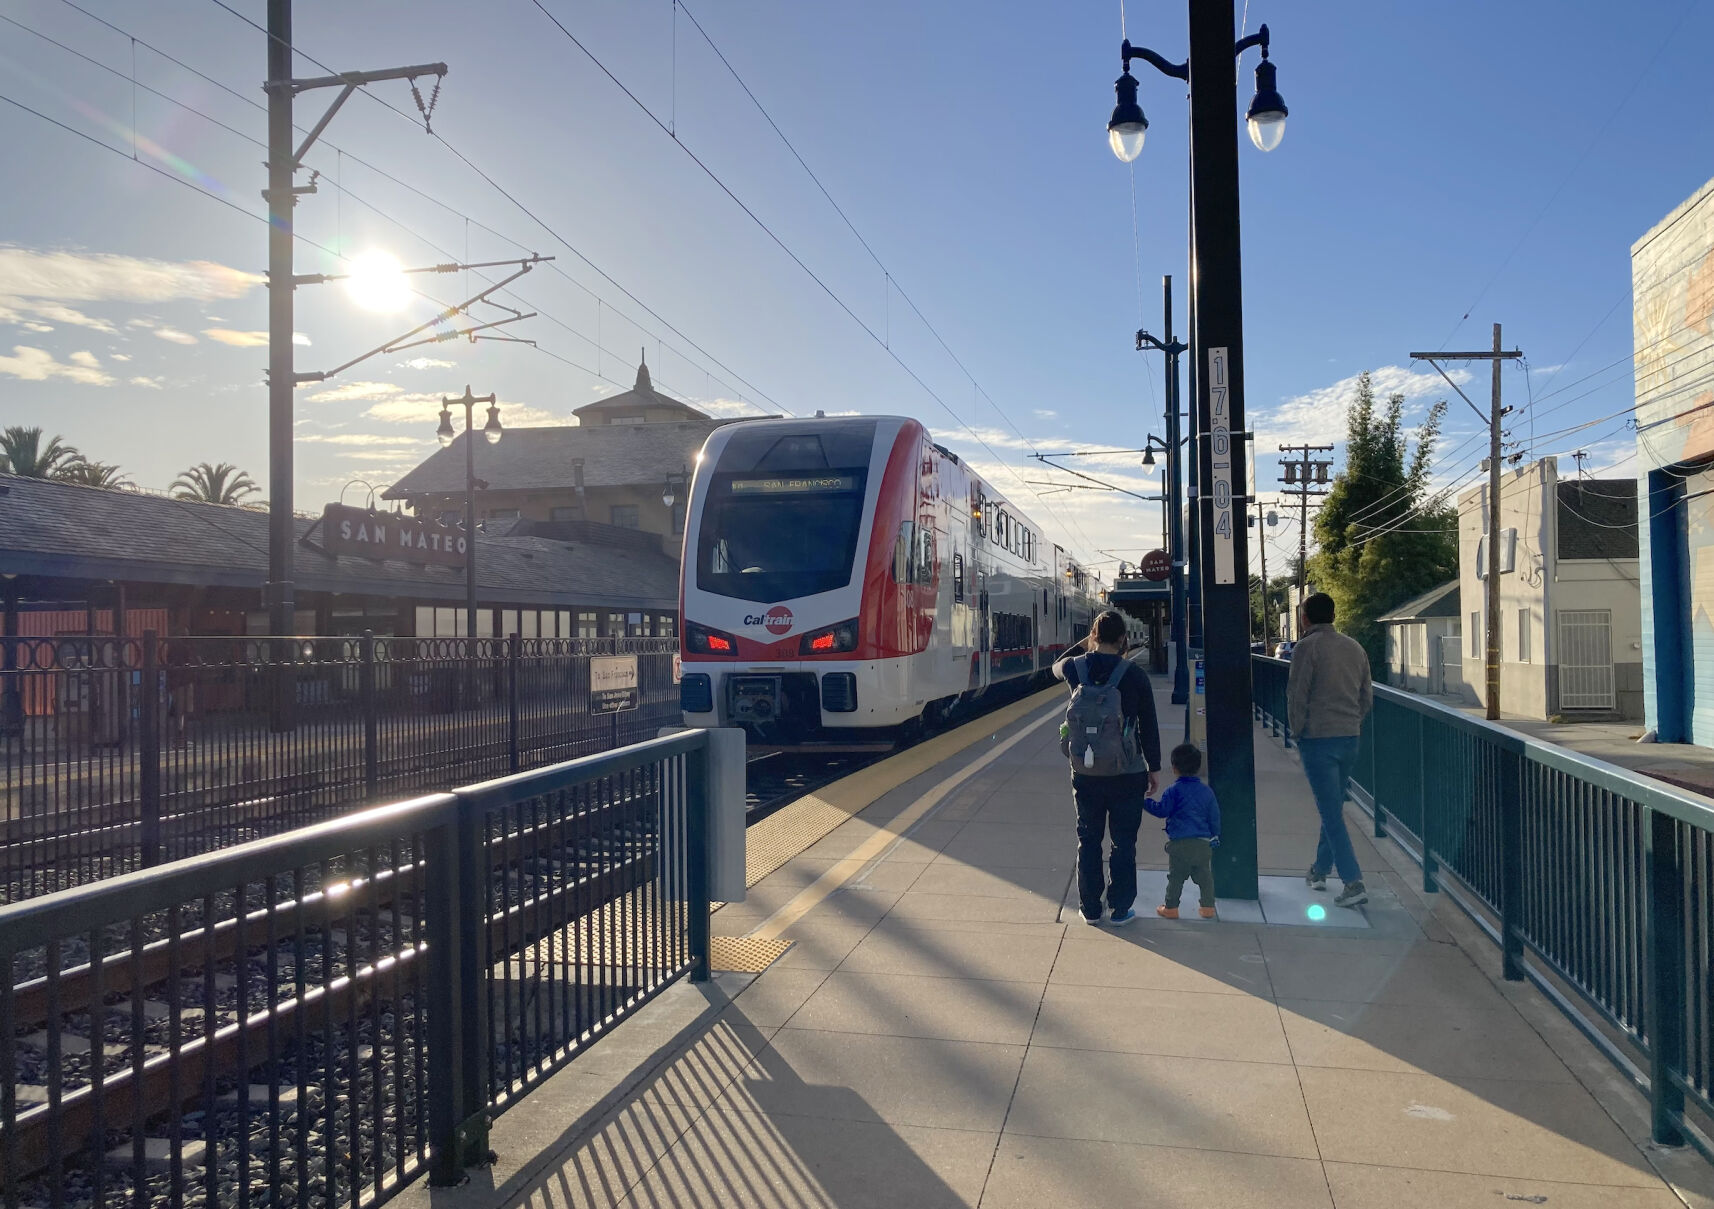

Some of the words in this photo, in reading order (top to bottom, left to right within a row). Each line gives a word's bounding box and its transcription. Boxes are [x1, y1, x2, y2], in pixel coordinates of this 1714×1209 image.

[340, 519, 386, 545] SAN
[399, 528, 467, 555] MATEO
[1145, 565, 1170, 573] MATEO
[743, 613, 795, 626] Caltrain
